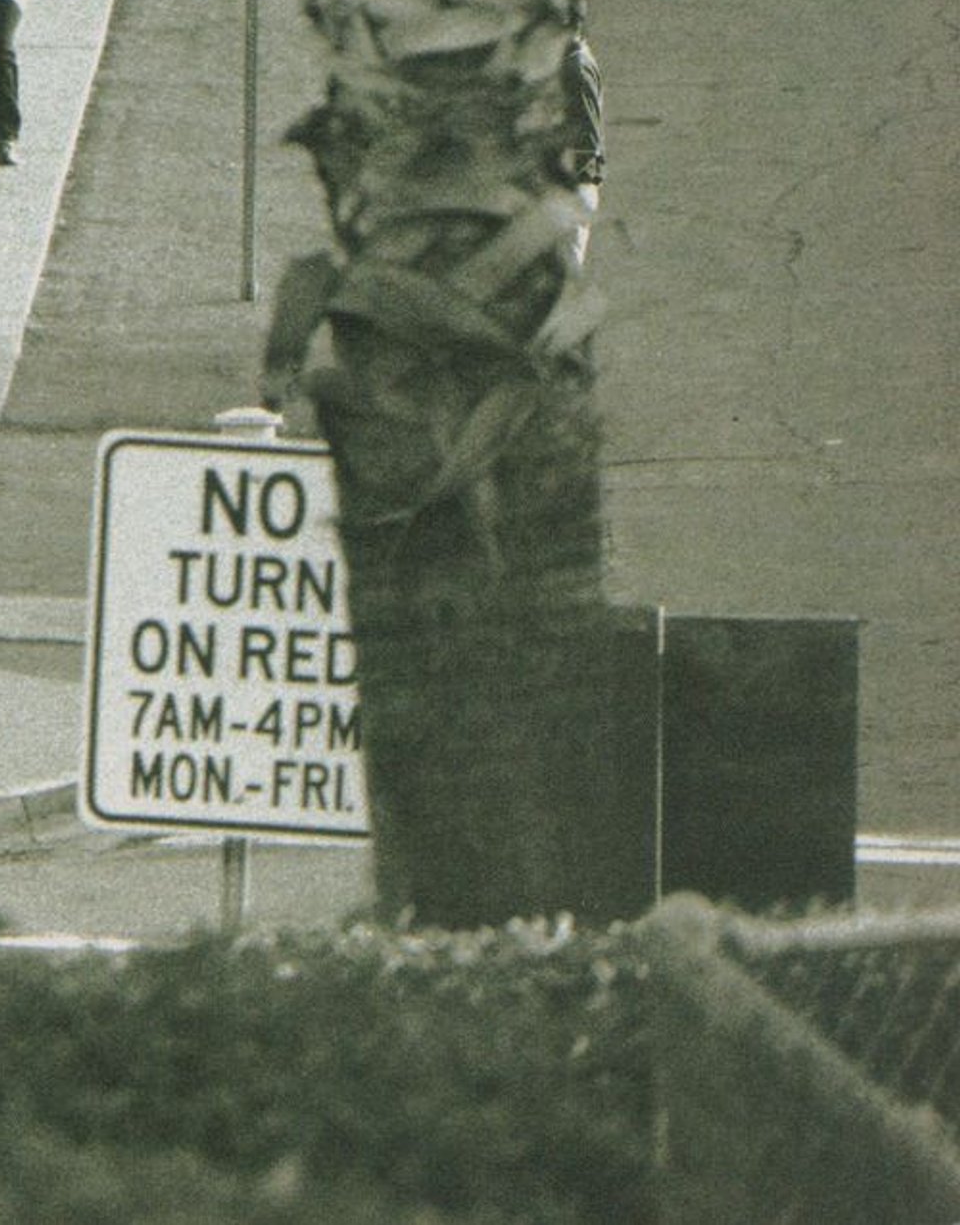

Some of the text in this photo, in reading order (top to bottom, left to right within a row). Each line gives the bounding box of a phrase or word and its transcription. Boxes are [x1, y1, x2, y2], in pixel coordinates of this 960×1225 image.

[202, 469, 306, 539] NO
[169, 551, 334, 613] TURN
[132, 619, 359, 685] ON RED
